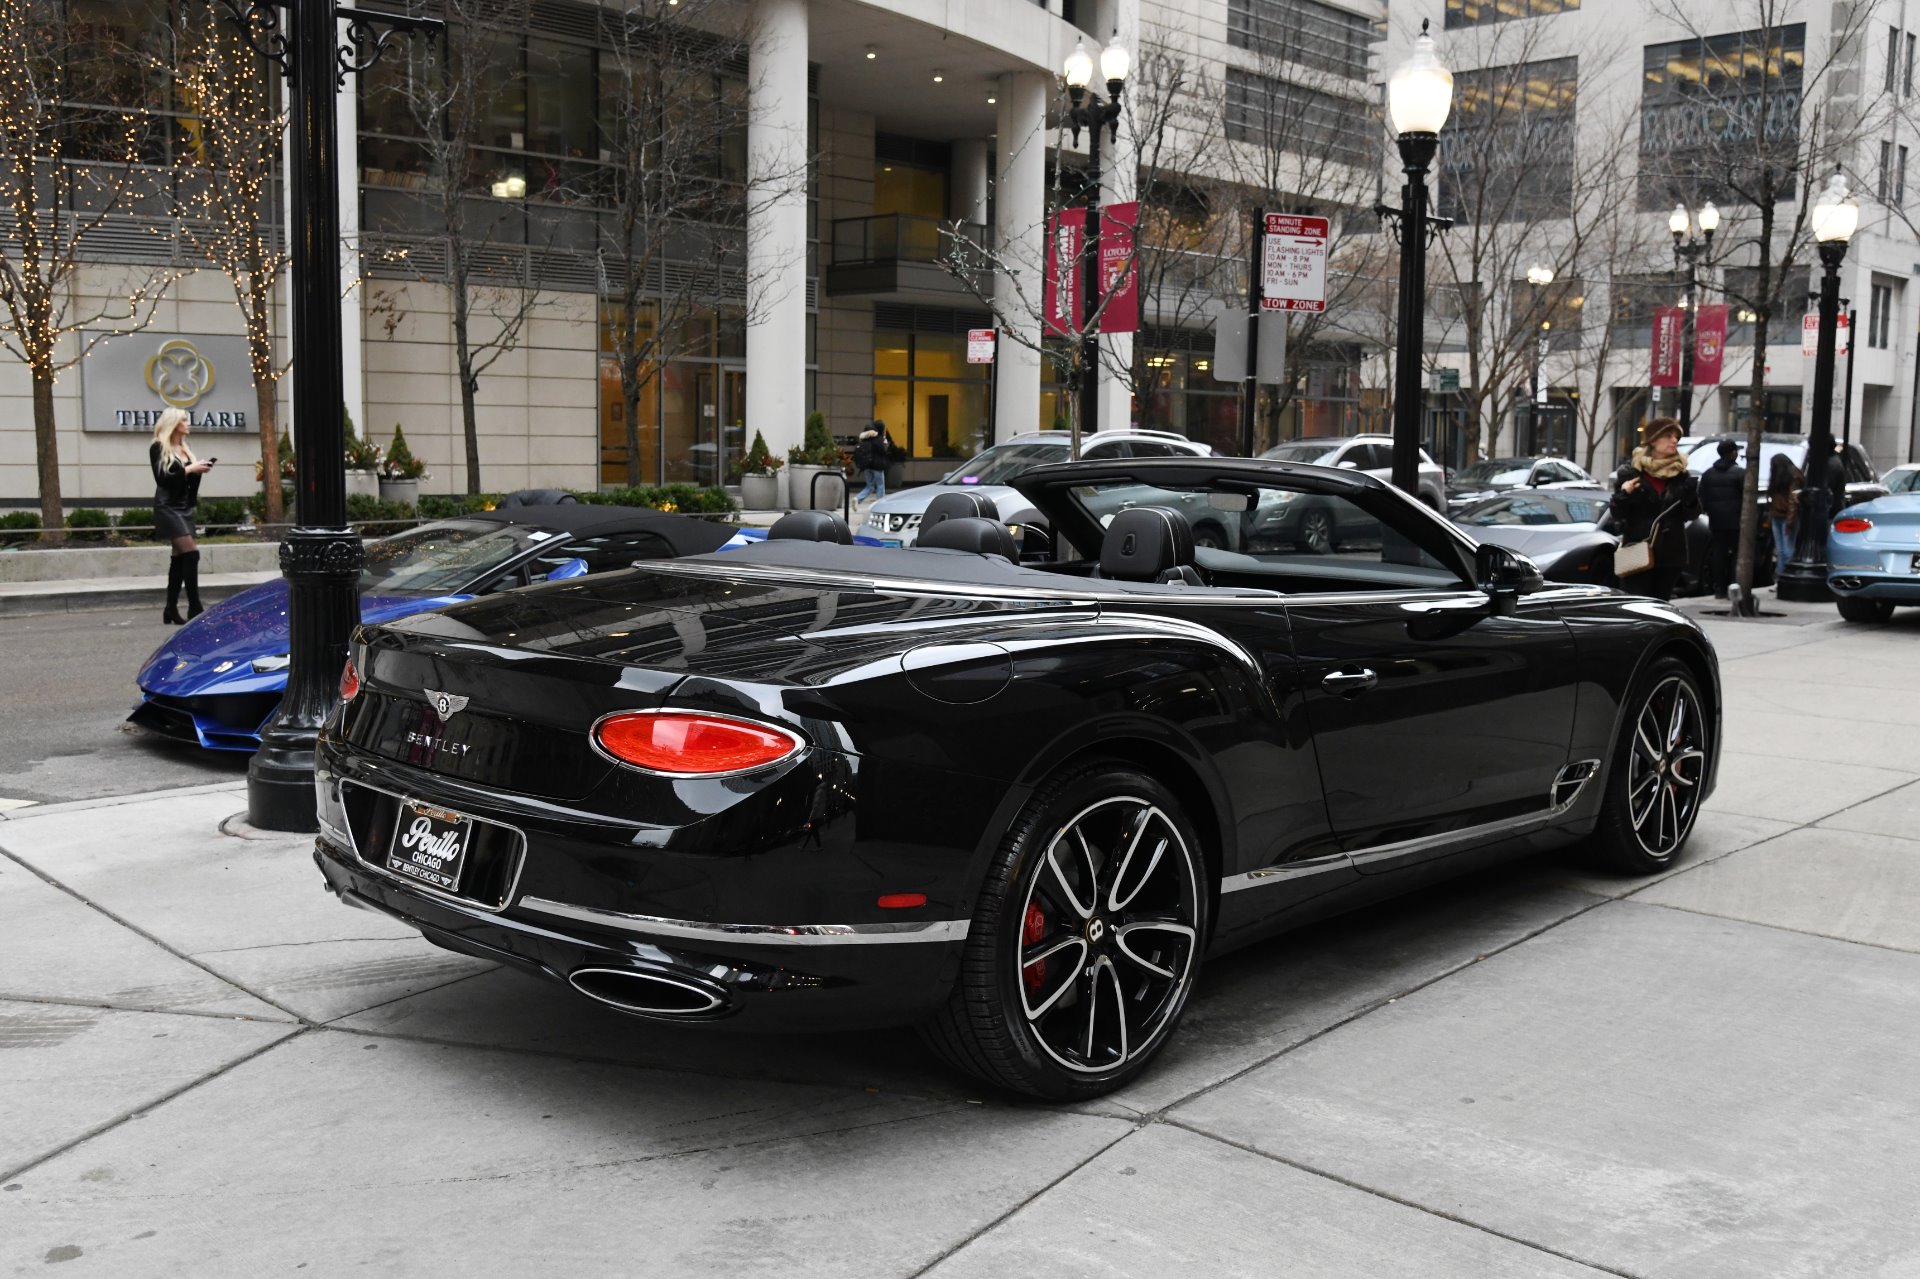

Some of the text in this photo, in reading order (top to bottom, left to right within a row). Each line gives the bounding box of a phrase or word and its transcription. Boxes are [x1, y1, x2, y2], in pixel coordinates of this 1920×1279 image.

[1269, 216, 1303, 226] 15 MINUTE
[1269, 225, 1322, 236] STANDING ZONE
[1103, 247, 1132, 258] LOYOLA
[1268, 246, 1324, 256] FLASHING LIGHTS
[1290, 263, 1312, 272] THURS
[1266, 298, 1319, 310] TOW ZONE
[1658, 316, 1670, 376] WELCOME
[188, 410, 246, 427] LARE
[407, 731, 471, 757] BENTLEY
[402, 816, 460, 862] Perillo
[412, 851, 442, 870] CHICAGO
[402, 863, 440, 882] BENTLEY CHICAGO
